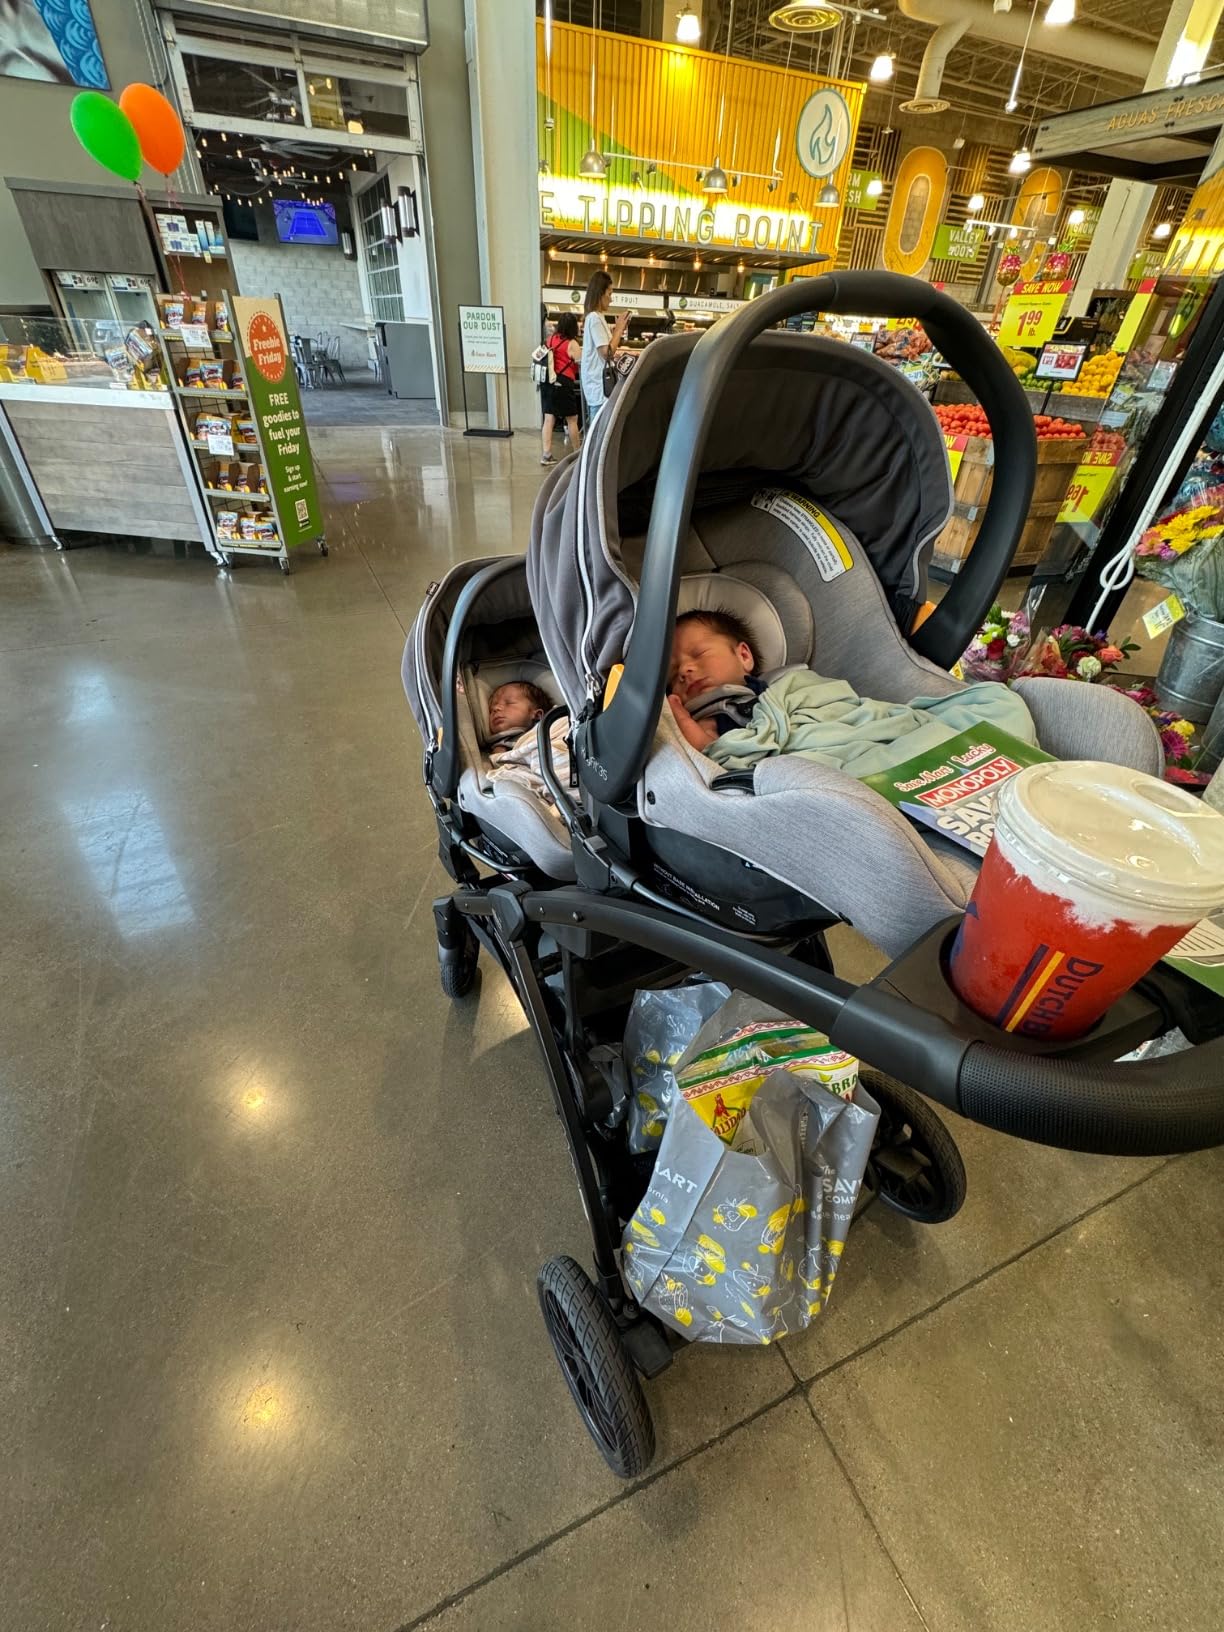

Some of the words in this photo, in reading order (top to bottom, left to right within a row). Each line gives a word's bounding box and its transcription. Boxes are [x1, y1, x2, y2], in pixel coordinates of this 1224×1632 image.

[1107, 107, 1159, 132] AGUAS
[539, 190, 555, 229] E
[578, 194, 716, 246] TIPPING
[734, 213, 824, 255] POINT
[949, 229, 980, 244] VALLEY
[1021, 282, 1042, 293] SAVE
[1042, 282, 1064, 293] NOW
[466, 312, 496, 321] PARDON
[463, 321, 478, 330] OUR
[481, 322, 501, 331] DUST
[252, 335, 280, 351] Freebie
[258, 351, 282, 366] Friday
[268, 392, 289, 407] FREE
[262, 410, 292, 427] goodies
[291, 409, 300, 420] to
[268, 427, 285, 441] fuel
[285, 426, 301, 440] your
[277, 442, 300, 456] Friday
[791, 492, 821, 518] WARNING
[951, 743, 997, 765] Lucky
[922, 759, 1013, 806] MONOPOLY
[1031, 956, 1104, 1020] DUTCH
[711, 1106, 747, 1137] ALIDAD
[823, 1177, 863, 1194] SAV
[648, 1186, 669, 1204] ornia
[825, 1194, 858, 1205] COMP
[833, 1211, 851, 1221] hea
